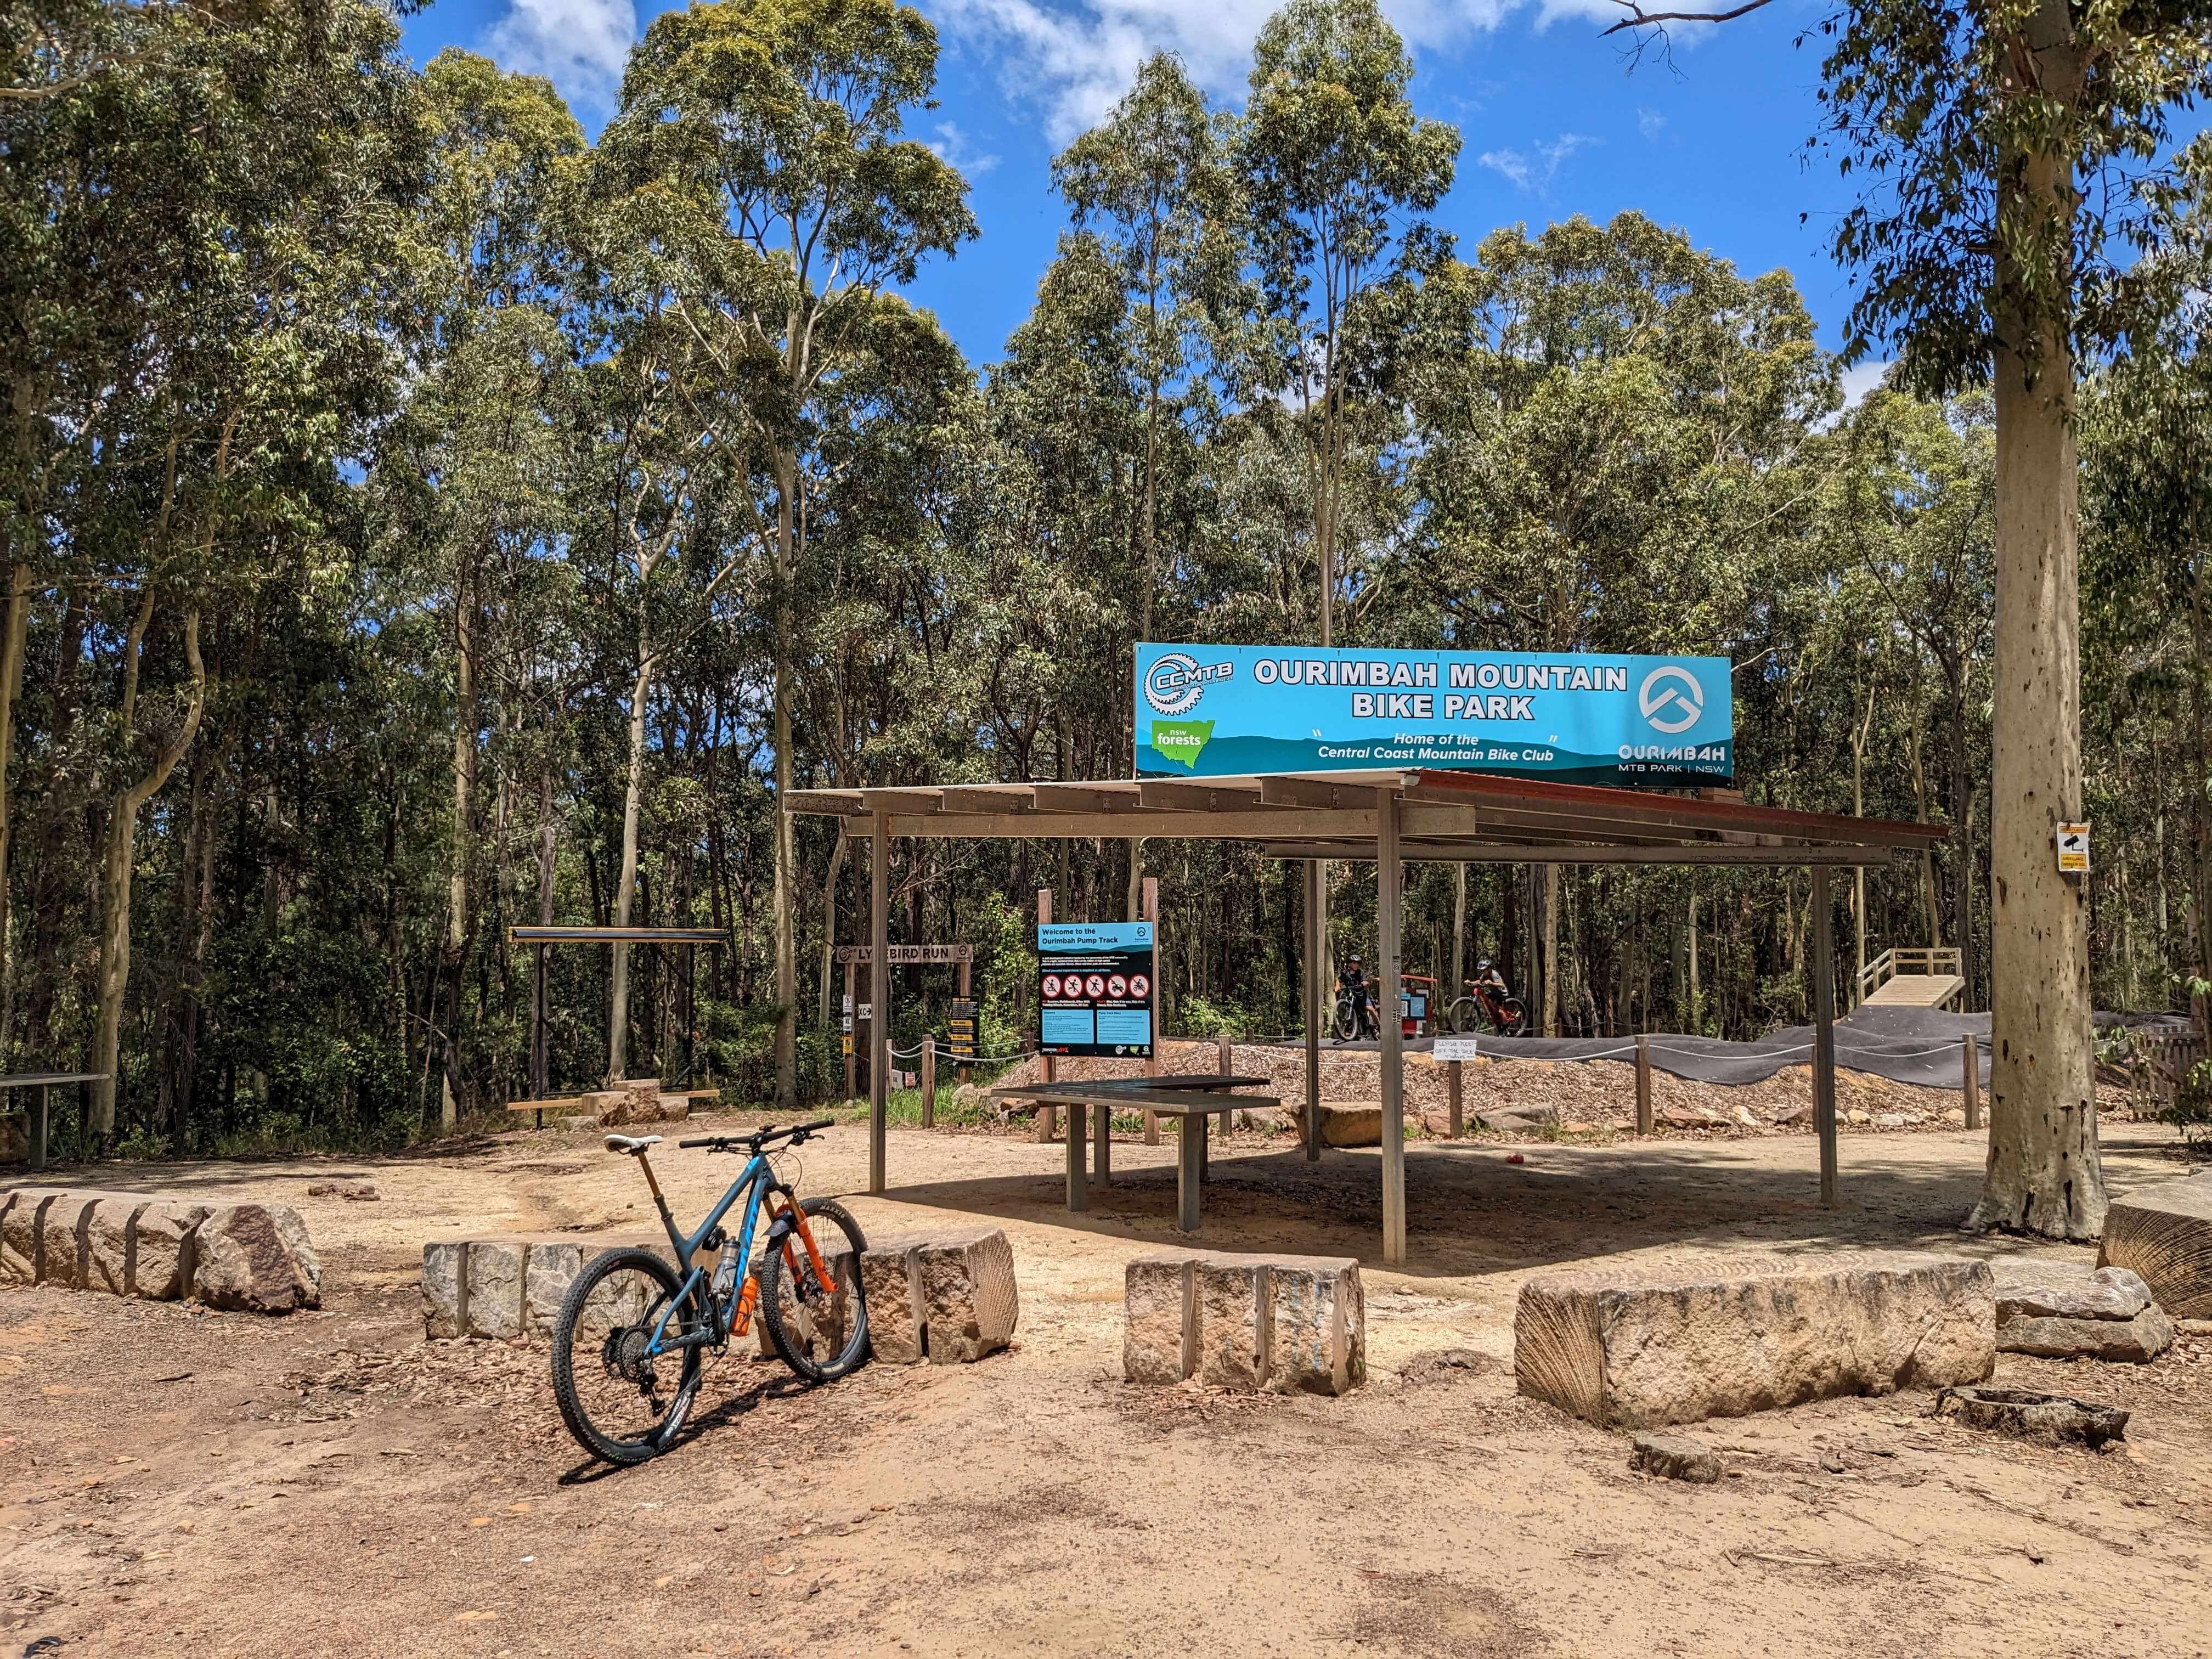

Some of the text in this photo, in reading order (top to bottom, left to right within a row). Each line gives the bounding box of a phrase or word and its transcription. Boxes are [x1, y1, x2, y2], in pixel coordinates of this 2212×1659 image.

[1155, 662, 1233, 690] CCMTB
[1254, 659, 1627, 692] OURIMBAH MOUNTAIN
[1352, 693, 1536, 720] BIKE PARK
[1158, 732, 1201, 746] forests
[1394, 733, 1479, 746] Home of the
[1318, 746, 1554, 761] Central Coast Mountain Bike Club
[1618, 745, 1725, 761] OURIMBAH
[859, 948, 949, 960] LYBIRD RUN
